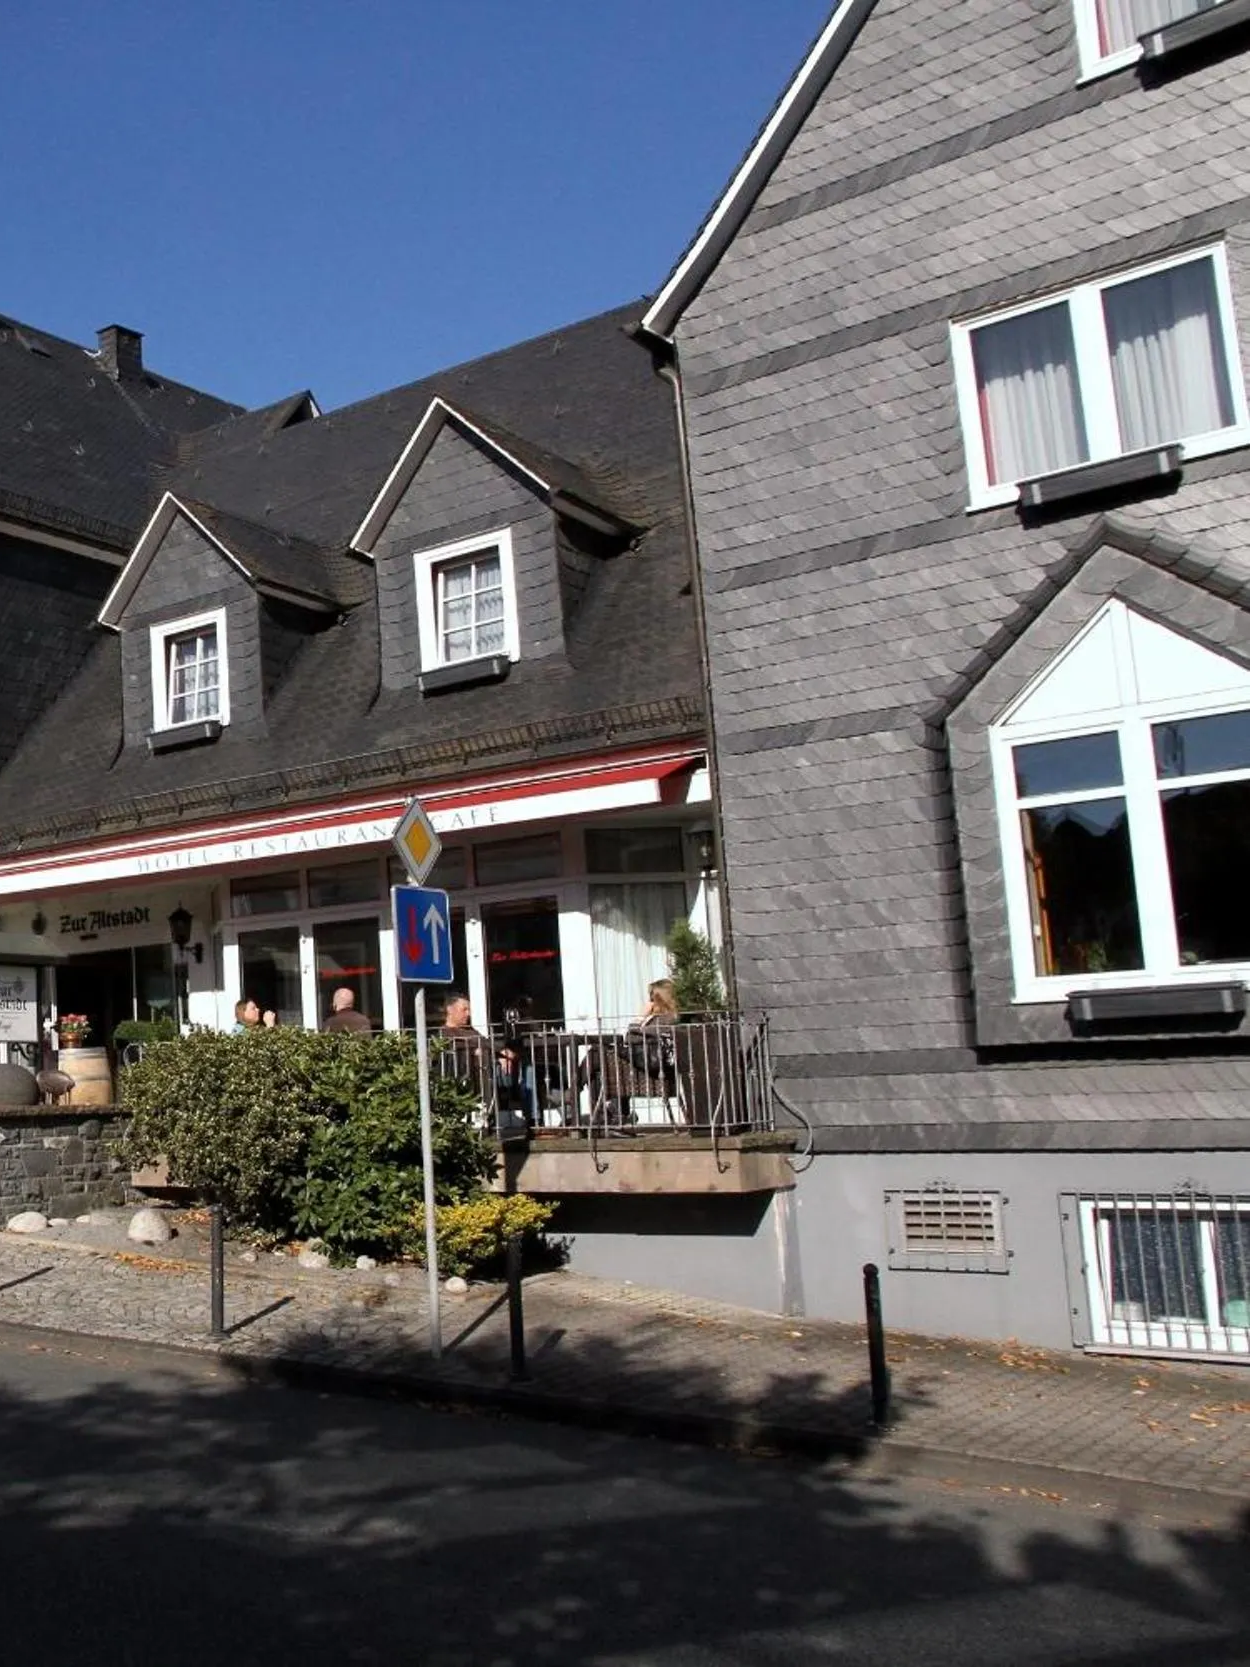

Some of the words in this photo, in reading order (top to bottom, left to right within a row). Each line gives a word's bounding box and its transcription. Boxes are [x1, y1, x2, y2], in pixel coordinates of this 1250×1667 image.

[233, 820, 401, 859] RESTAURAN
[59, 914, 87, 933] Zur
[88, 906, 151, 931] Altstadt
